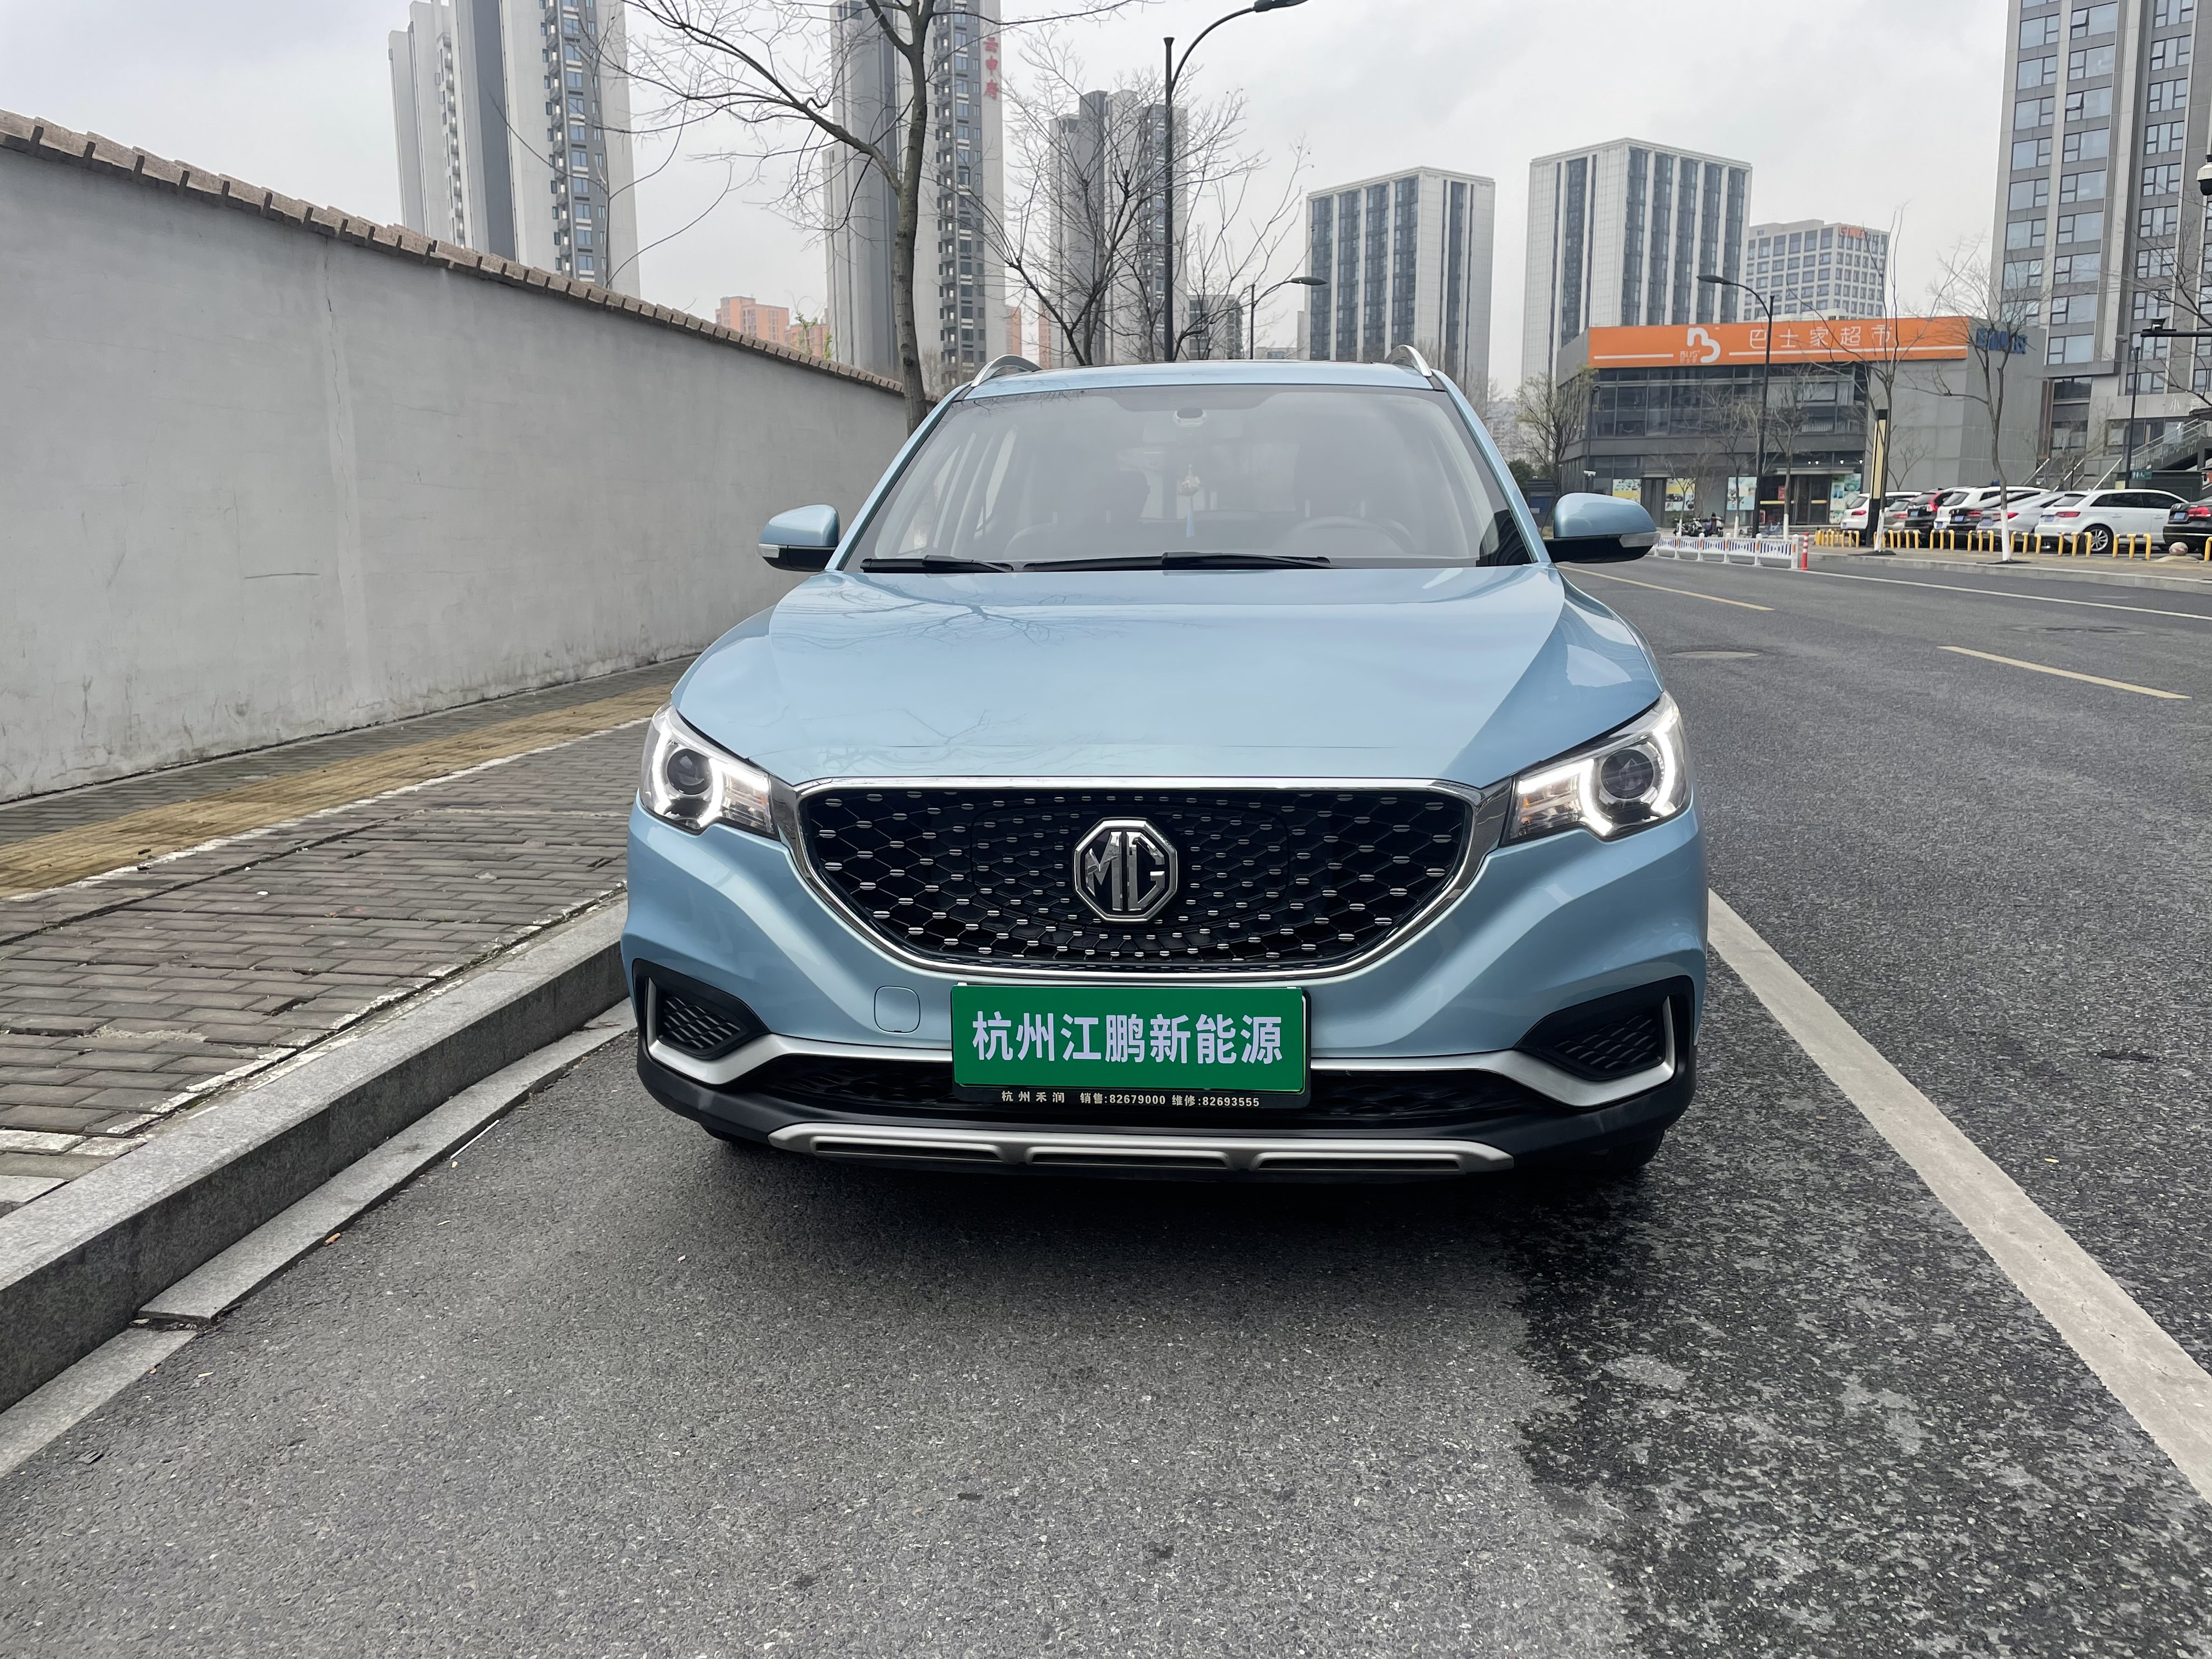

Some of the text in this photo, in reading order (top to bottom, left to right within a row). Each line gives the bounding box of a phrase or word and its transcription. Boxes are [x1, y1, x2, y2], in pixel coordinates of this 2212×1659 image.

[1750, 324, 1893, 349] 巴士家超市
[1085, 831, 1165, 911] MG
[972, 1011, 1283, 1064] 杭州江鹏新能源
[1001, 1090, 1260, 1107] 杭州禾润 销售:82679000 维修:82693555
